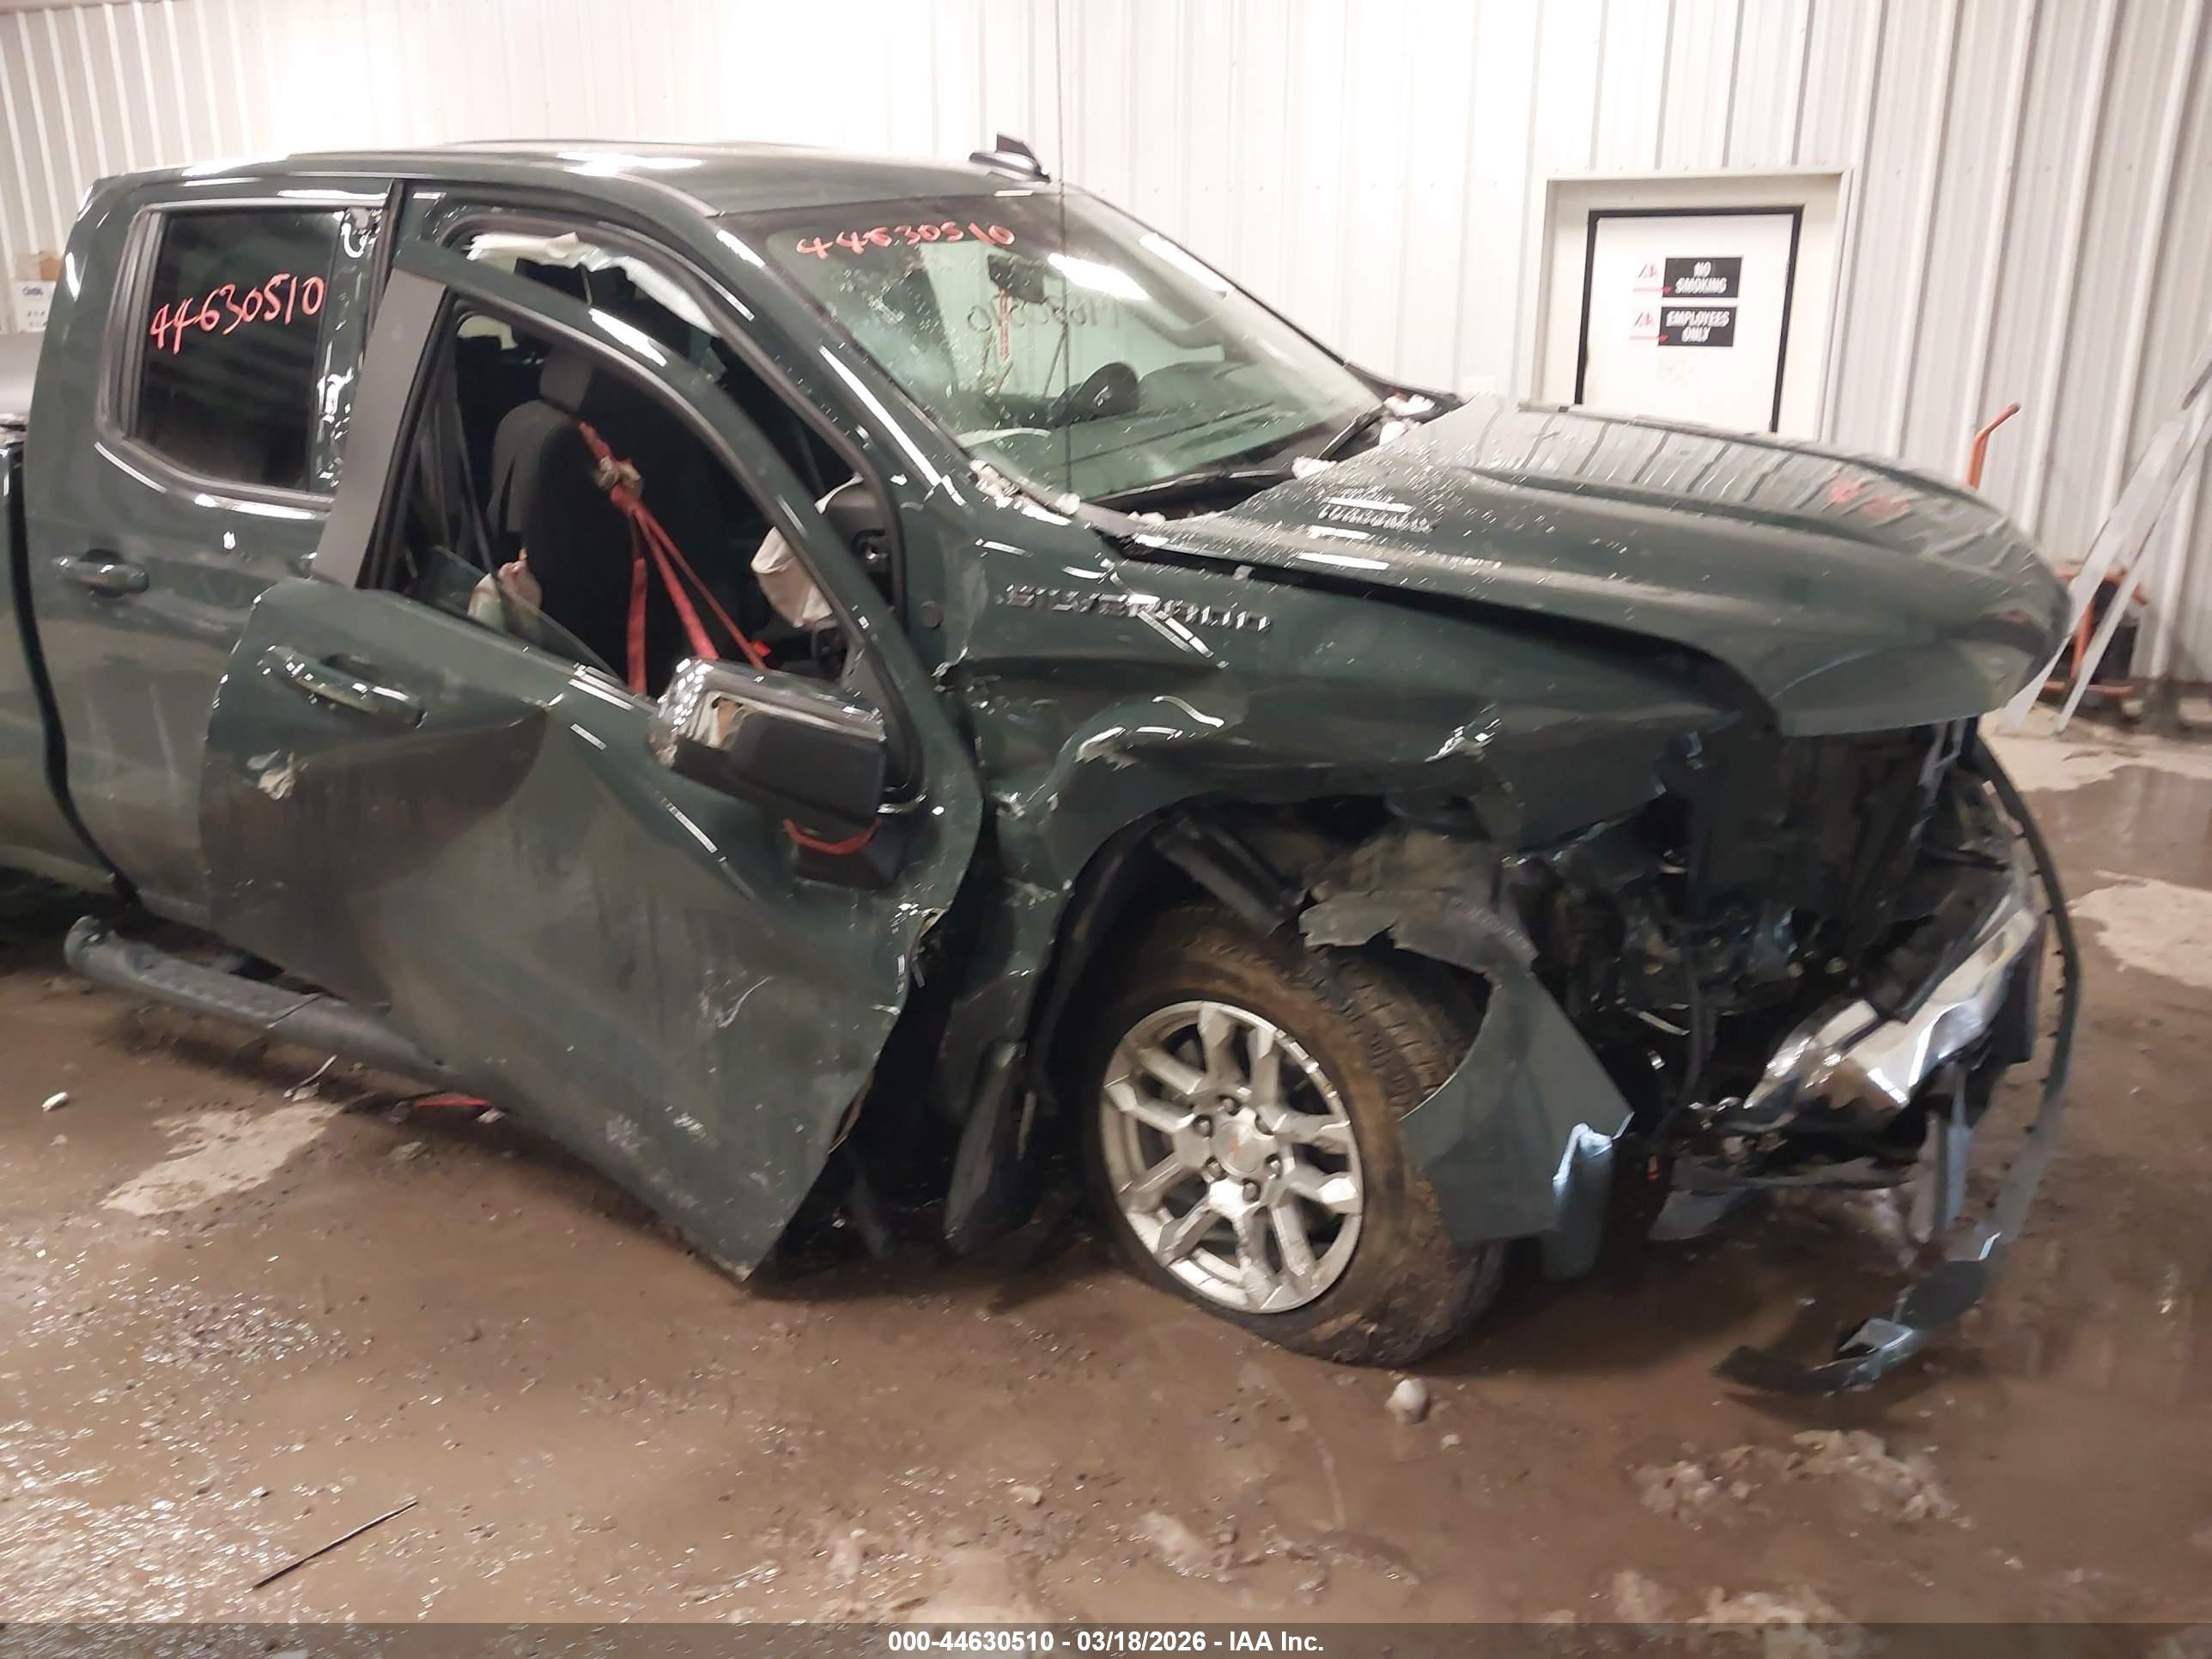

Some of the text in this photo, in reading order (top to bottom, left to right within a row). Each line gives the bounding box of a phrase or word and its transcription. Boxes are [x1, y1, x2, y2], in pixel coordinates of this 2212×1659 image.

[796, 221, 1015, 259] 44630510
[1693, 261, 1711, 277] NO
[1674, 277, 1728, 294] SMOKING
[150, 272, 325, 355] 44630510
[1666, 310, 1730, 327] EMPLOYEES
[1681, 326, 1711, 343] ONLY
